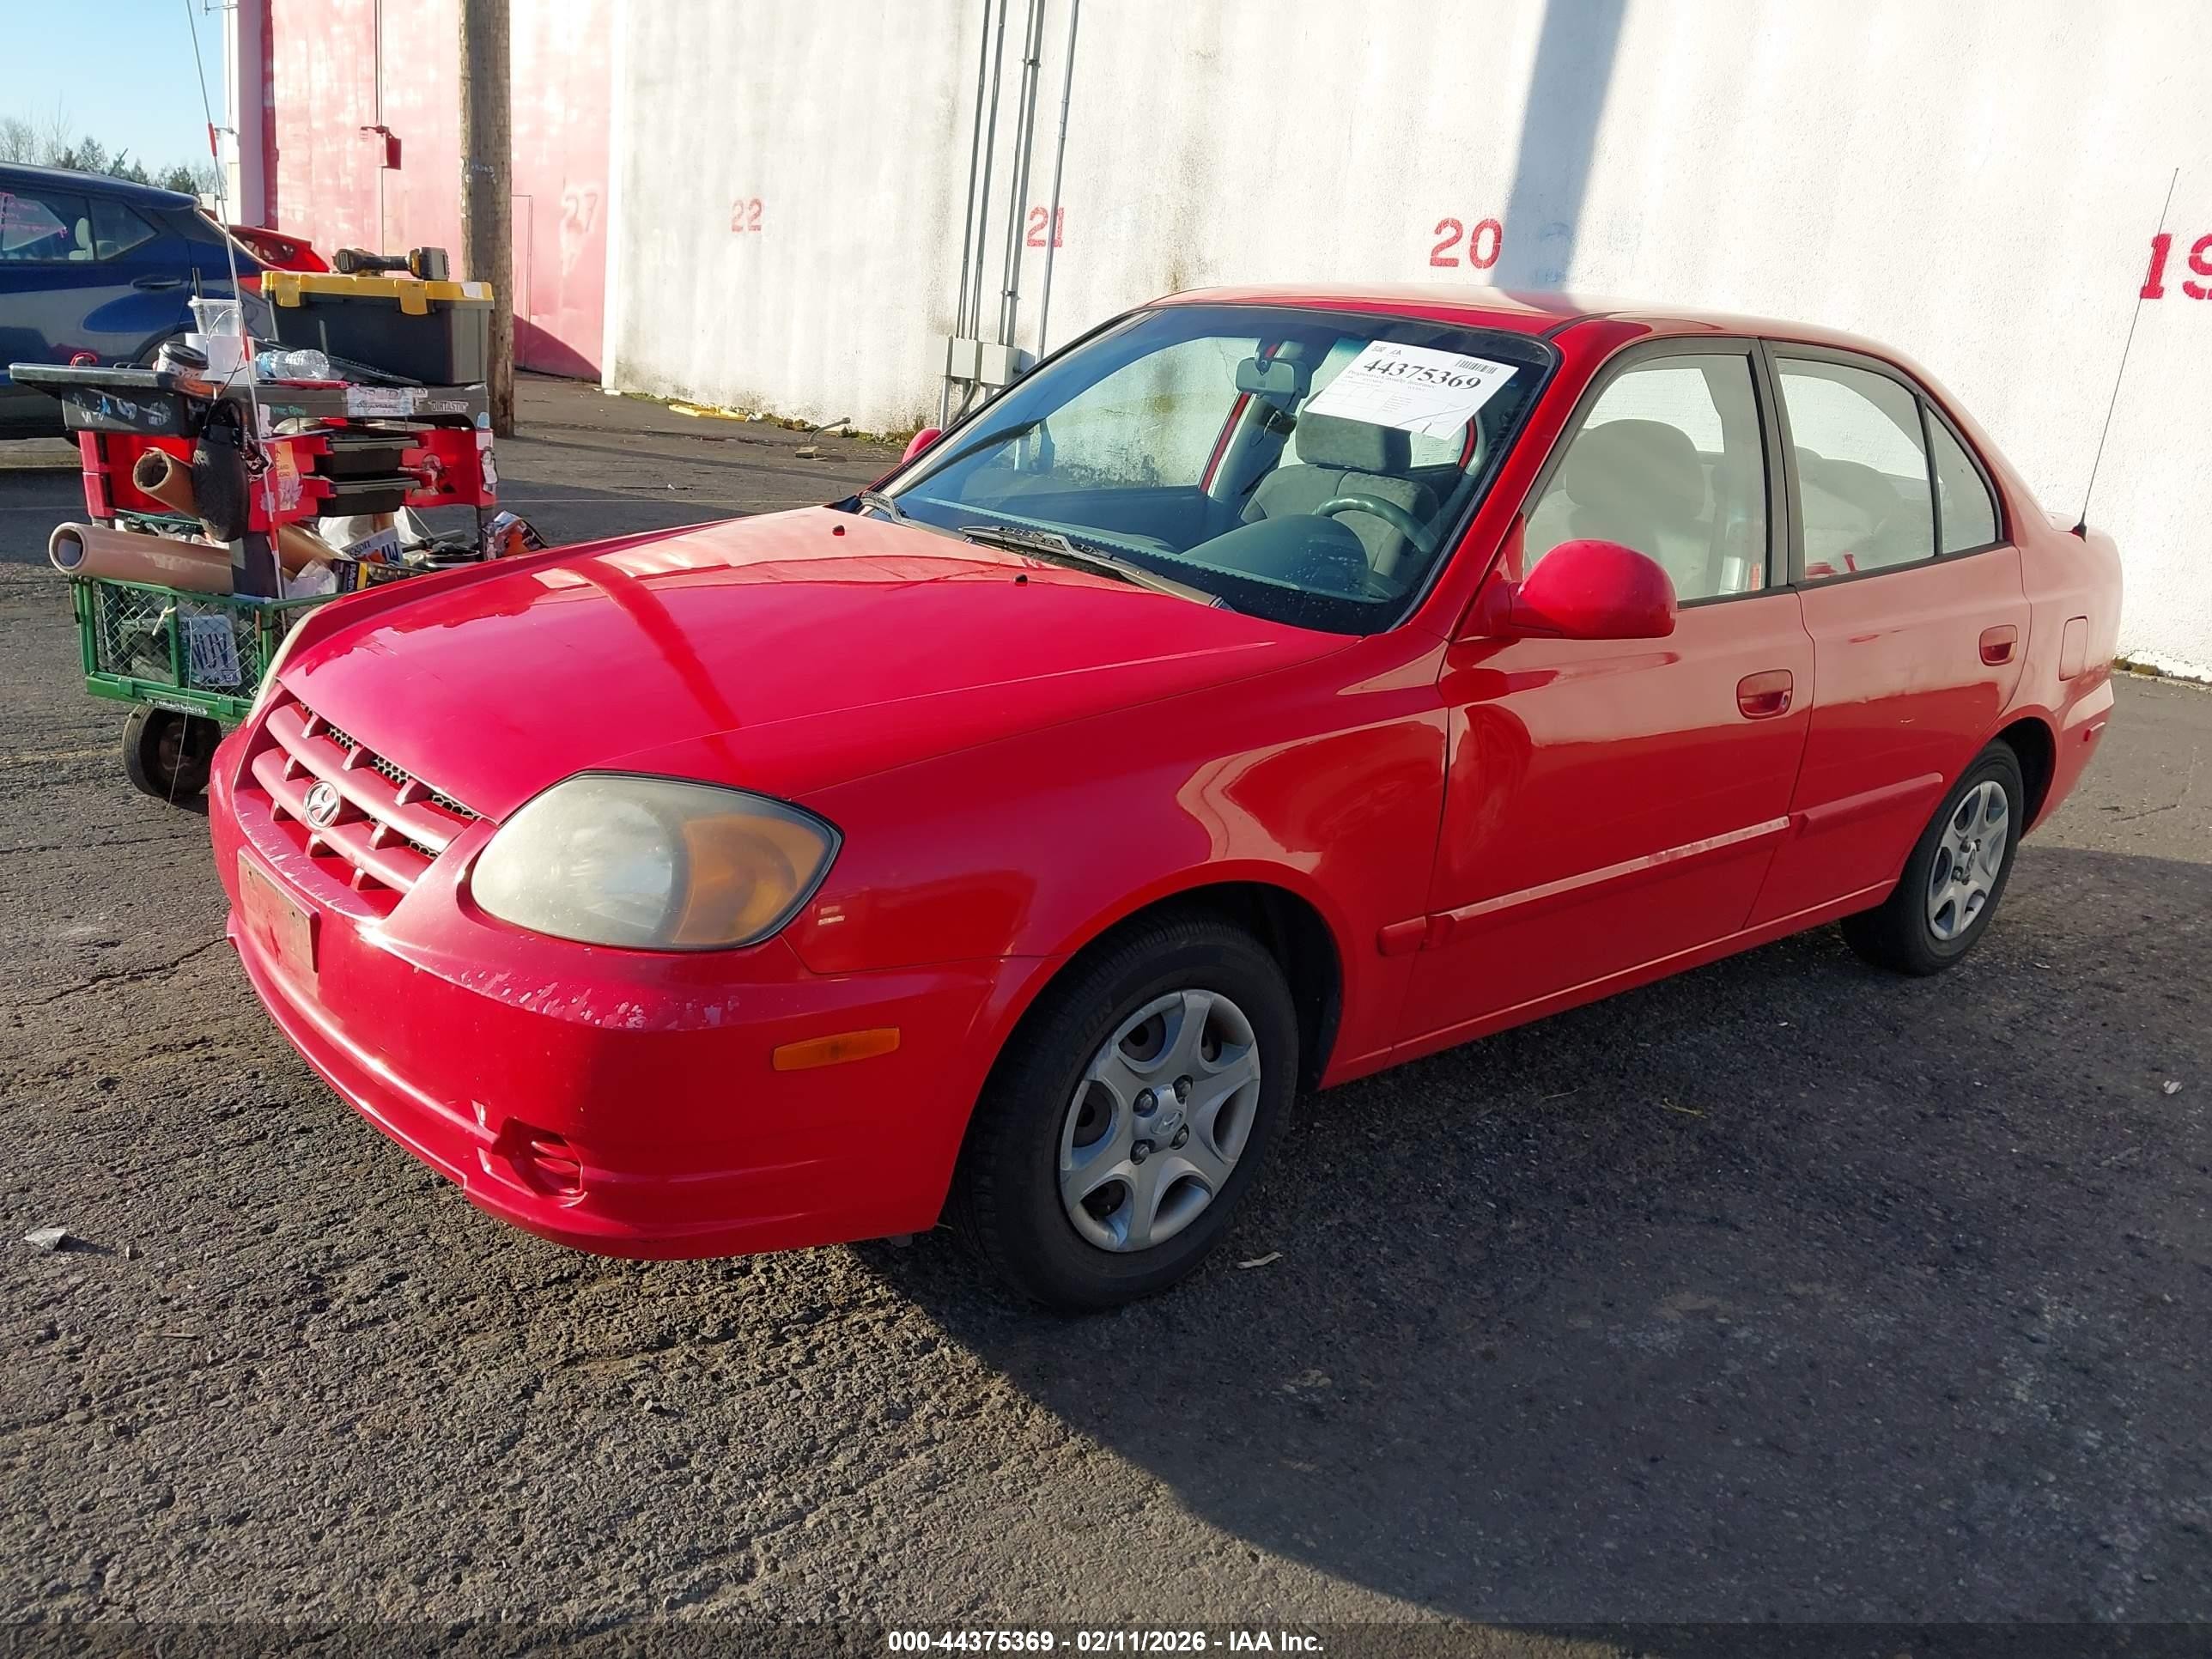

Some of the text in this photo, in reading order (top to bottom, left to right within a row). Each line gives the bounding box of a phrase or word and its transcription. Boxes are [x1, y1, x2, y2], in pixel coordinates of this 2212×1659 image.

[731, 198, 763, 232] 22
[1027, 207, 1064, 247] 21
[1430, 217, 1502, 270] 20
[2140, 233, 2212, 300] 19
[1364, 359, 1481, 390] 44375369
